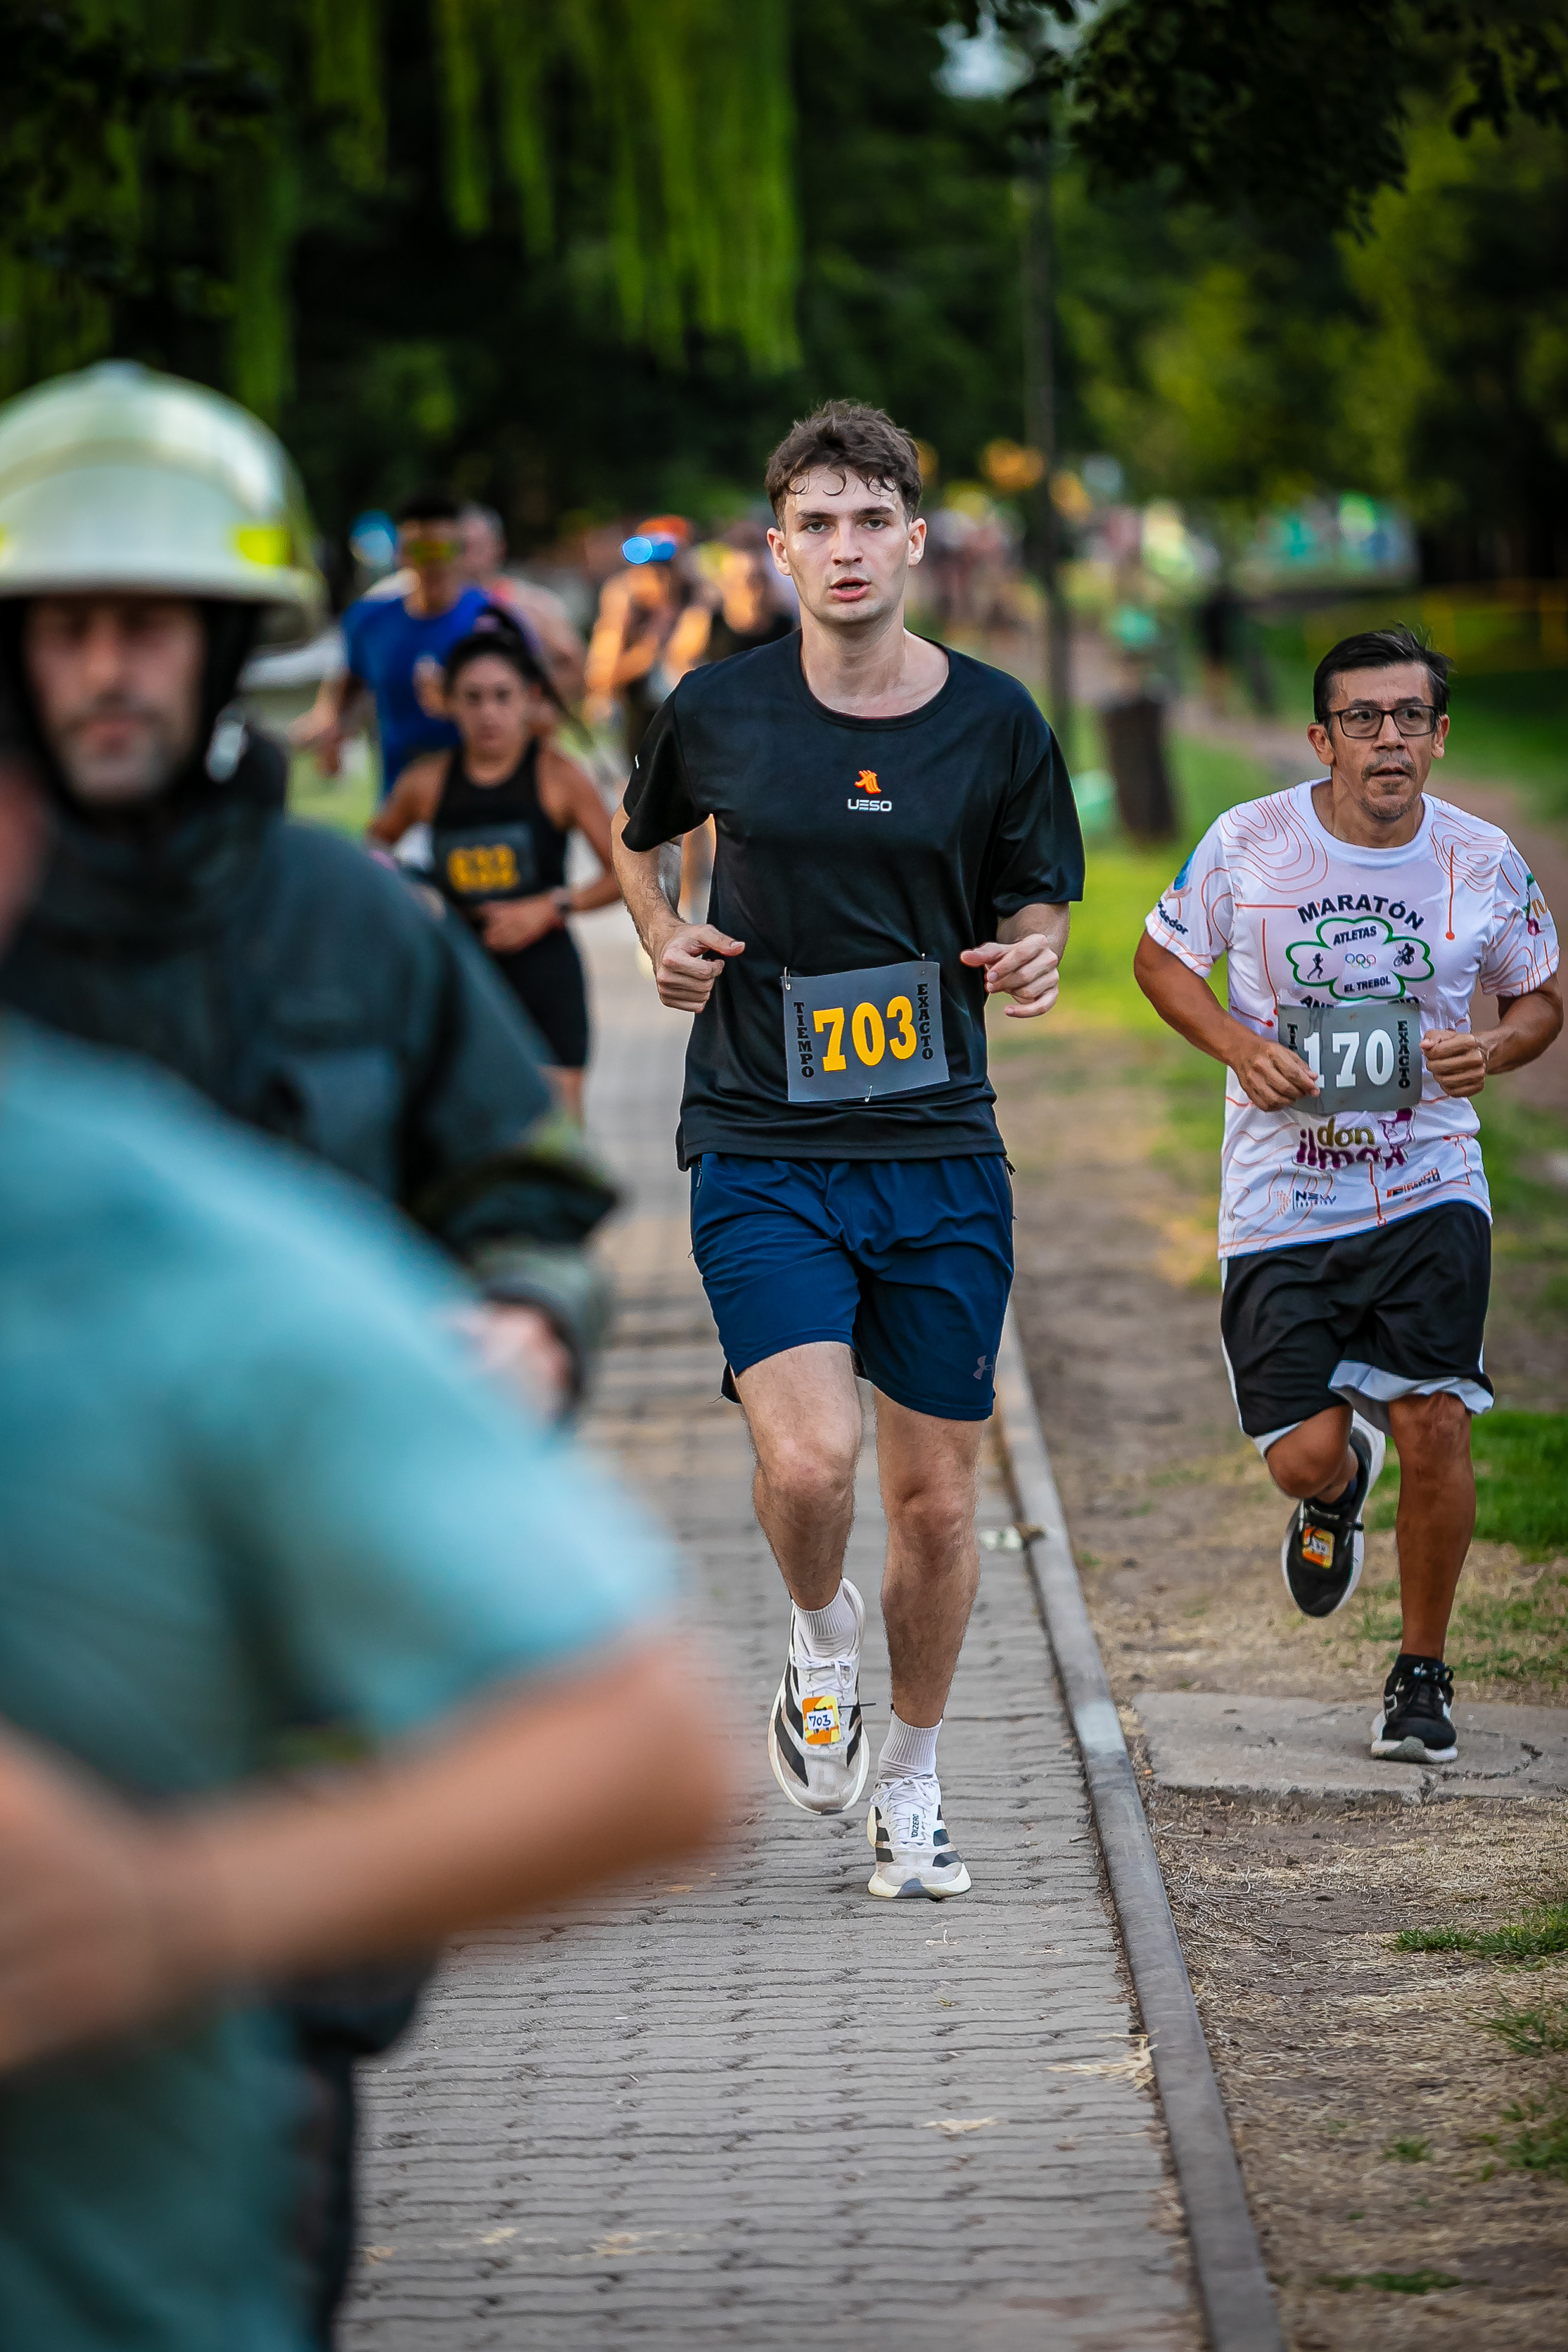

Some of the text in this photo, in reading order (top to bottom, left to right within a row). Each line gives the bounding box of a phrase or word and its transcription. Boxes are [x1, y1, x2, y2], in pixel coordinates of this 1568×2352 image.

[848, 799, 892, 812] UESO
[1297, 893, 1425, 932] MARATÓN
[1332, 925, 1377, 946] ATLETAS
[1344, 975, 1391, 993] EL TREBOL
[793, 1001, 815, 1079] TIEMPO
[812, 996, 917, 1072] 703
[917, 982, 934, 1061] EXACTO
[1304, 1028, 1395, 1089] 170
[1396, 1019, 1411, 1089] EXACTO
[1317, 1114, 1377, 1148] don
[808, 1714, 831, 1727] 703
